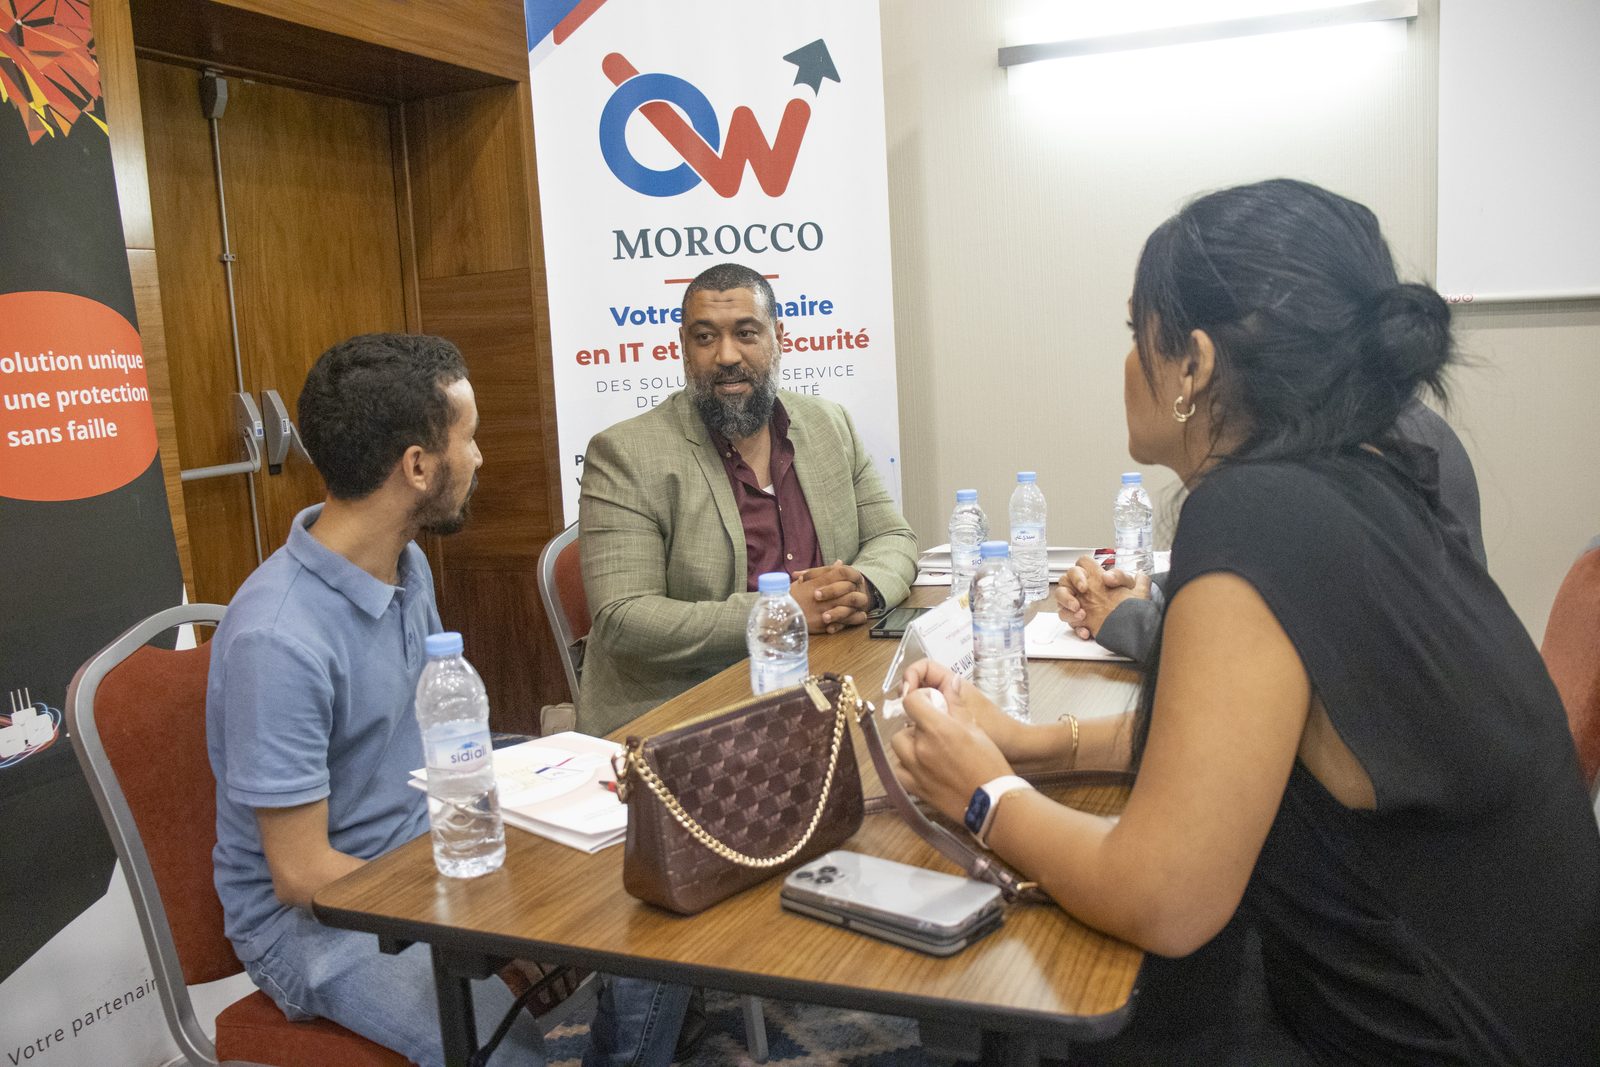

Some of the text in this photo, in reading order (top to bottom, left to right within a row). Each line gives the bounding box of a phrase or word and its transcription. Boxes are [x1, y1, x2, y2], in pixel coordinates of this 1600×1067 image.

[612, 222, 824, 260] MOROCCO
[609, 306, 683, 326] Votre
[88, 349, 144, 374] unique
[576, 328, 870, 366] en IT et écurité
[596, 364, 855, 393] DES SOLU SERVICE
[4, 382, 149, 412] une protection
[7, 418, 118, 447] sans faille
[8, 978, 157, 1066] Votre partenair
